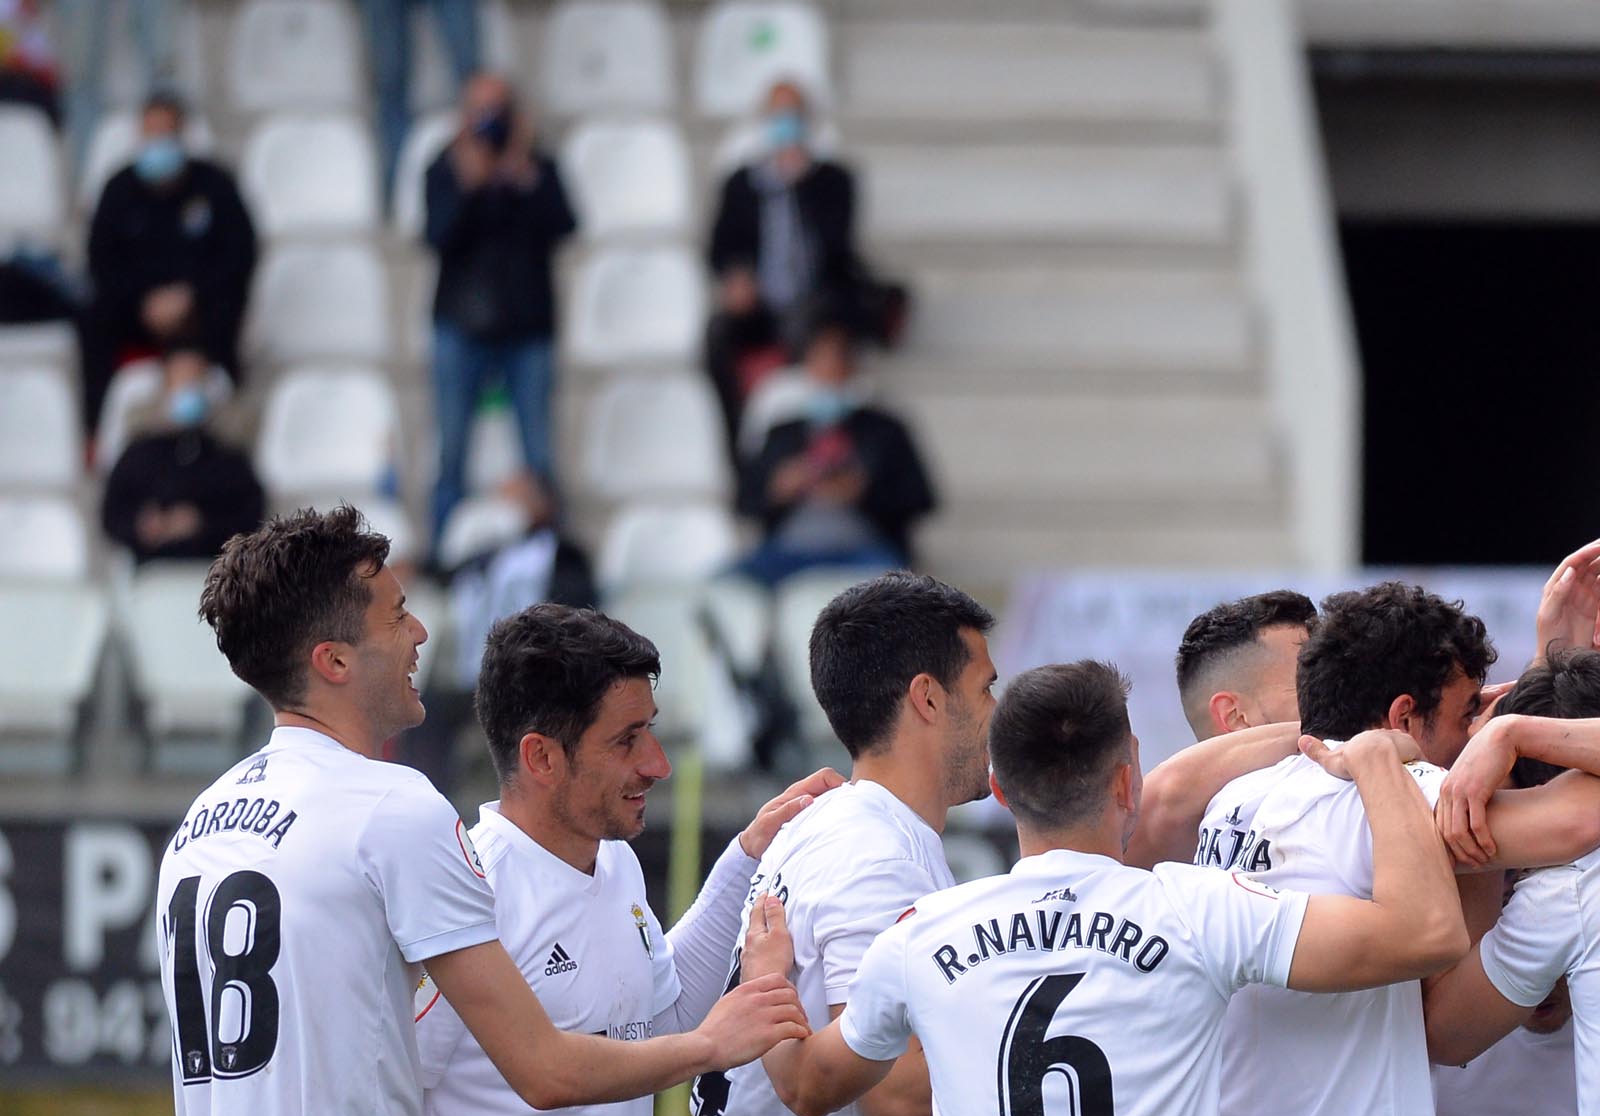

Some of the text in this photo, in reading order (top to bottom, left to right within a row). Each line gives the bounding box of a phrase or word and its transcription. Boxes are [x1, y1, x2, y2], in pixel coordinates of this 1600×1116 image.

[162, 869, 282, 1086] 18
[544, 959, 578, 977] adidas
[932, 909, 1170, 985] R.NAVARRO
